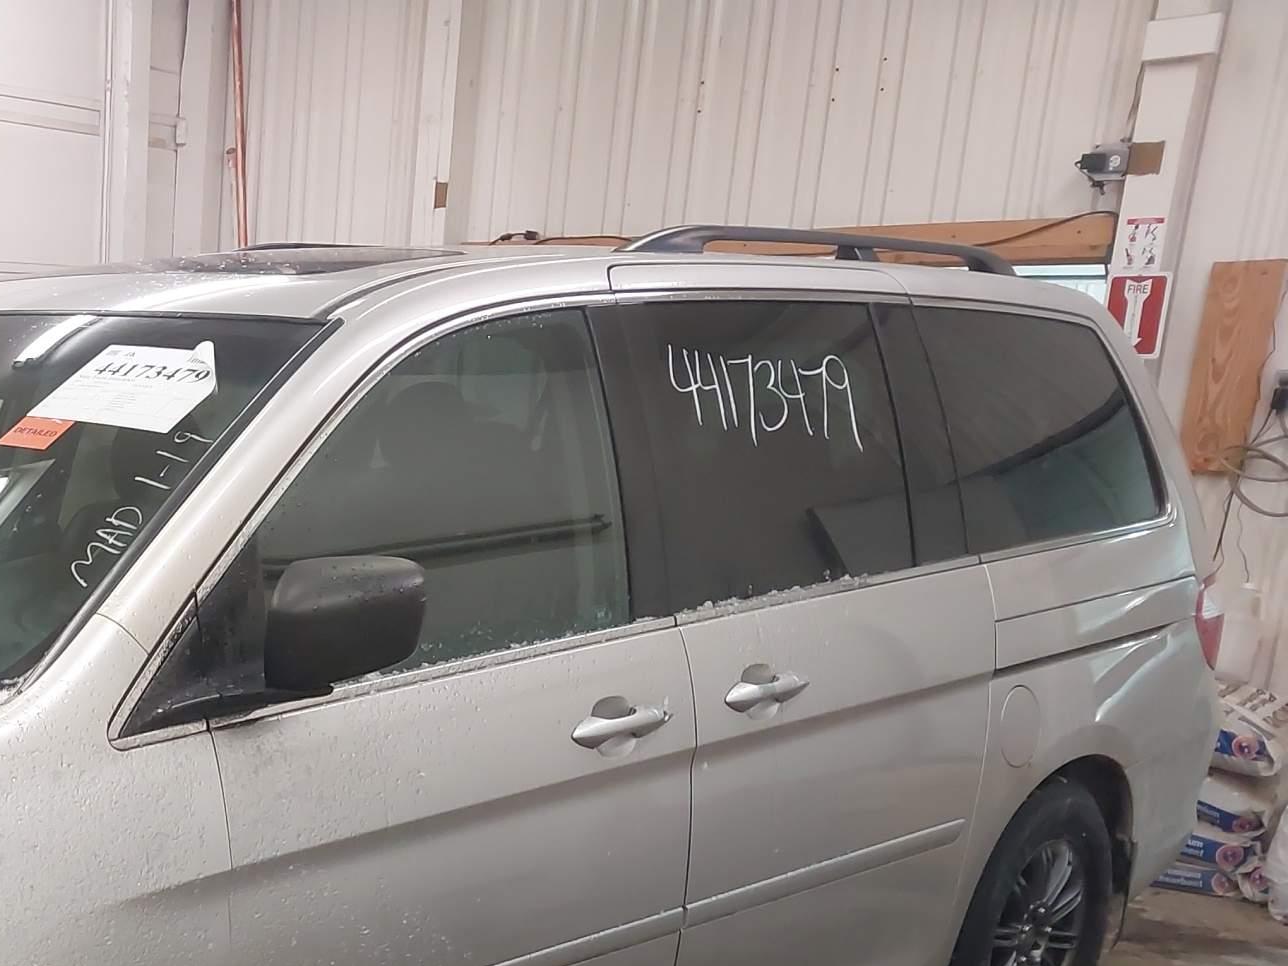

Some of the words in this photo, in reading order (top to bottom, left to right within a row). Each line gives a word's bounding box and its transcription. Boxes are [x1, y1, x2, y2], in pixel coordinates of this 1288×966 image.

[1128, 284, 1149, 294] FIRE
[94, 362, 210, 383] 44173479
[668, 344, 864, 452] 44173479
[14, 426, 57, 437] DETAILED
[71, 506, 143, 588] MAD
[135, 431, 214, 490] 1-19
